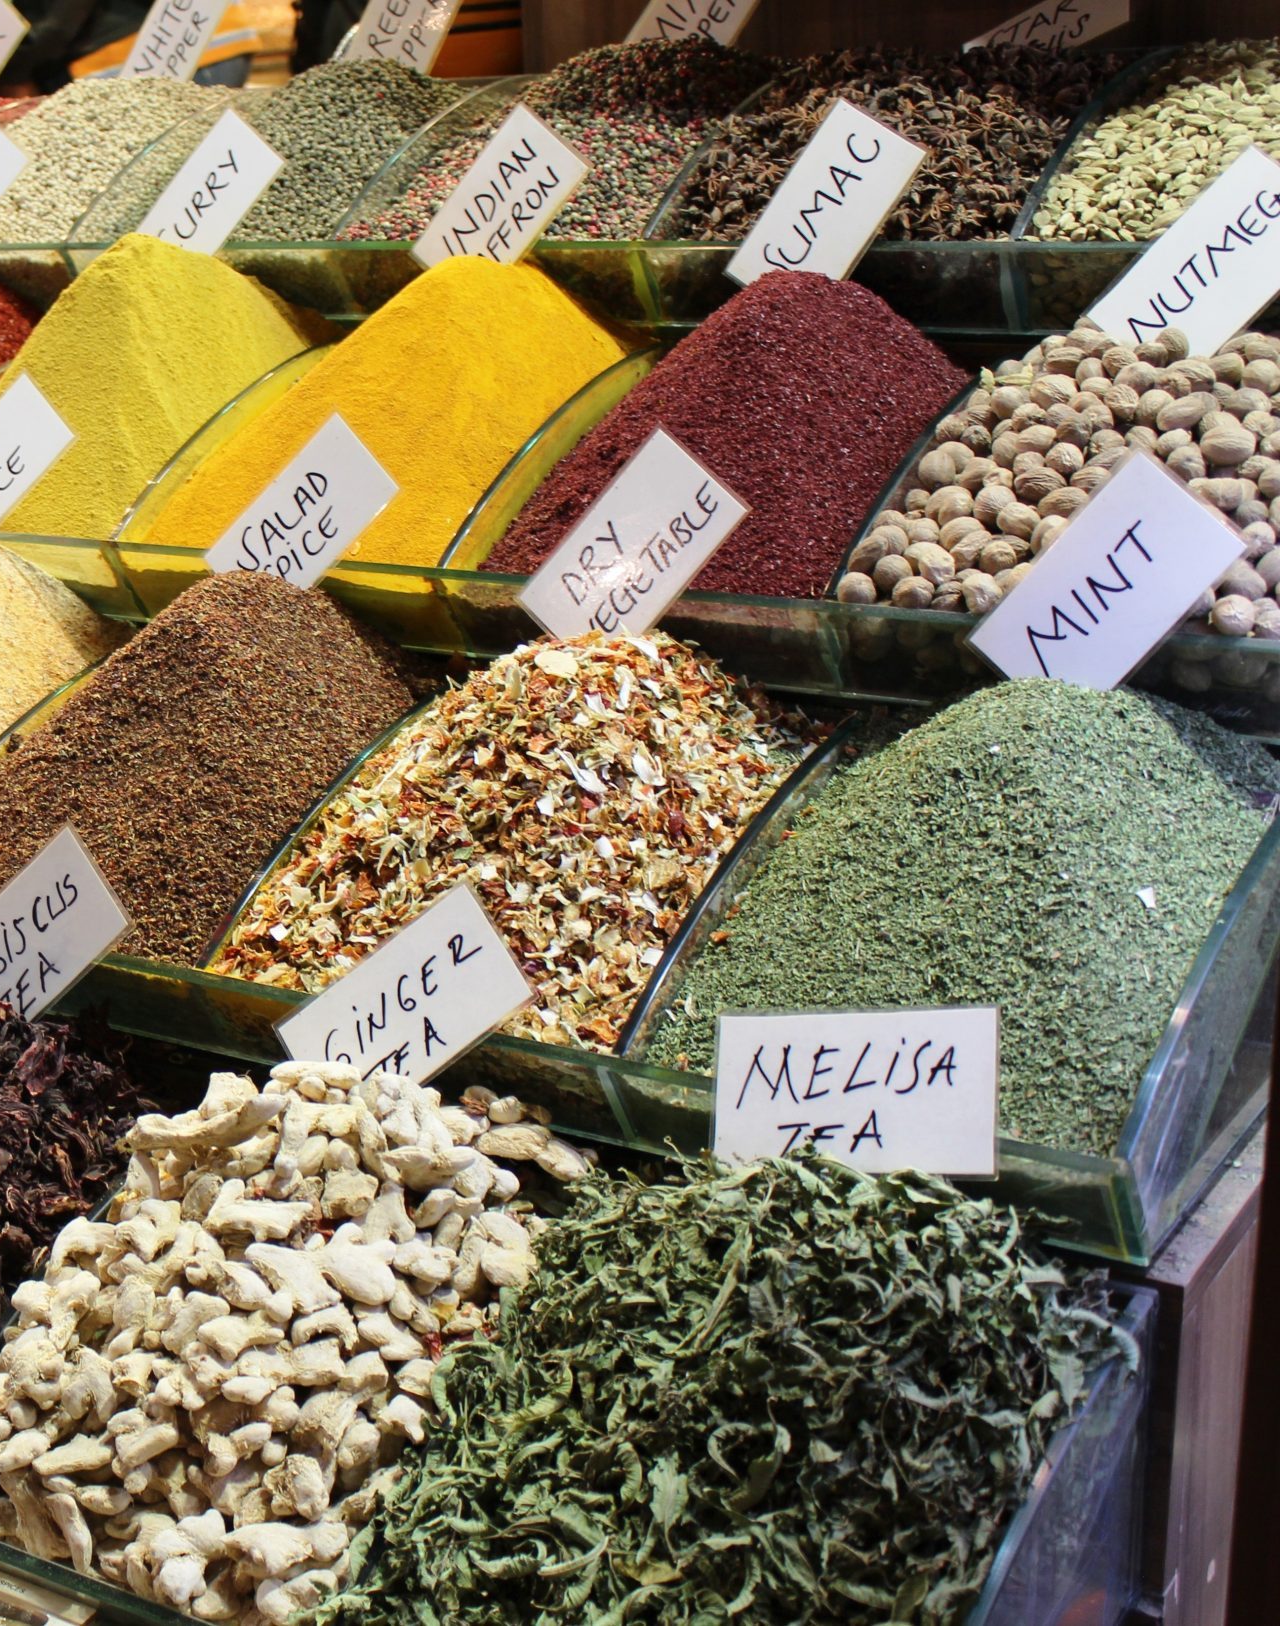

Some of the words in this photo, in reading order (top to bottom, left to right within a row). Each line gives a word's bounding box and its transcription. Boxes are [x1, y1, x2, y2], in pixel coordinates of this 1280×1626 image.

[162, 11, 209, 76] PPER
[367, 0, 410, 58] REE
[641, 0, 697, 42] MI
[441, 137, 538, 257] INDIAN
[476, 165, 560, 263] FFRON
[763, 132, 881, 271] SUMAC
[1127, 190, 1280, 344] NUTMEG
[236, 471, 329, 573] SALAD
[560, 520, 624, 606] DRY
[1026, 518, 1153, 678] MINT
